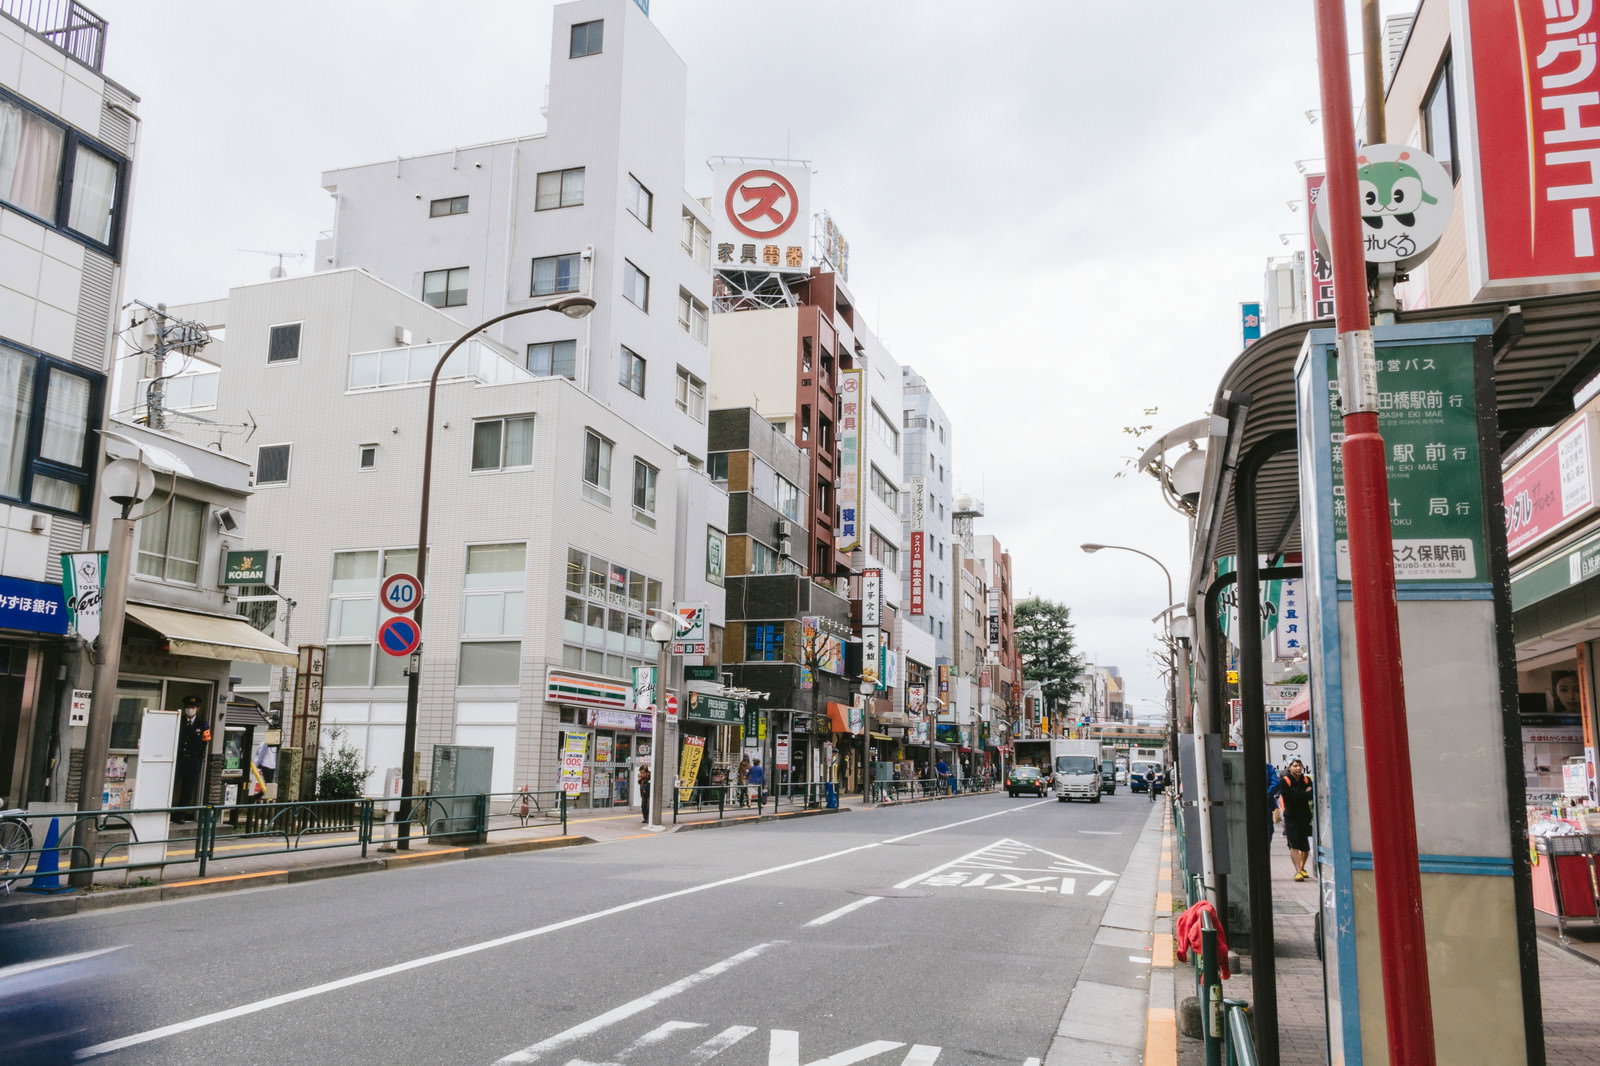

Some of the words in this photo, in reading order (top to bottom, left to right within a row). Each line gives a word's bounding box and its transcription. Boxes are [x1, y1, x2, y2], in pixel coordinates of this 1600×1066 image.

[738, 184, 786, 225] ス
[717, 243, 803, 267] 家具電器
[228, 569, 264, 580] KOBAN
[390, 584, 413, 603] 40
